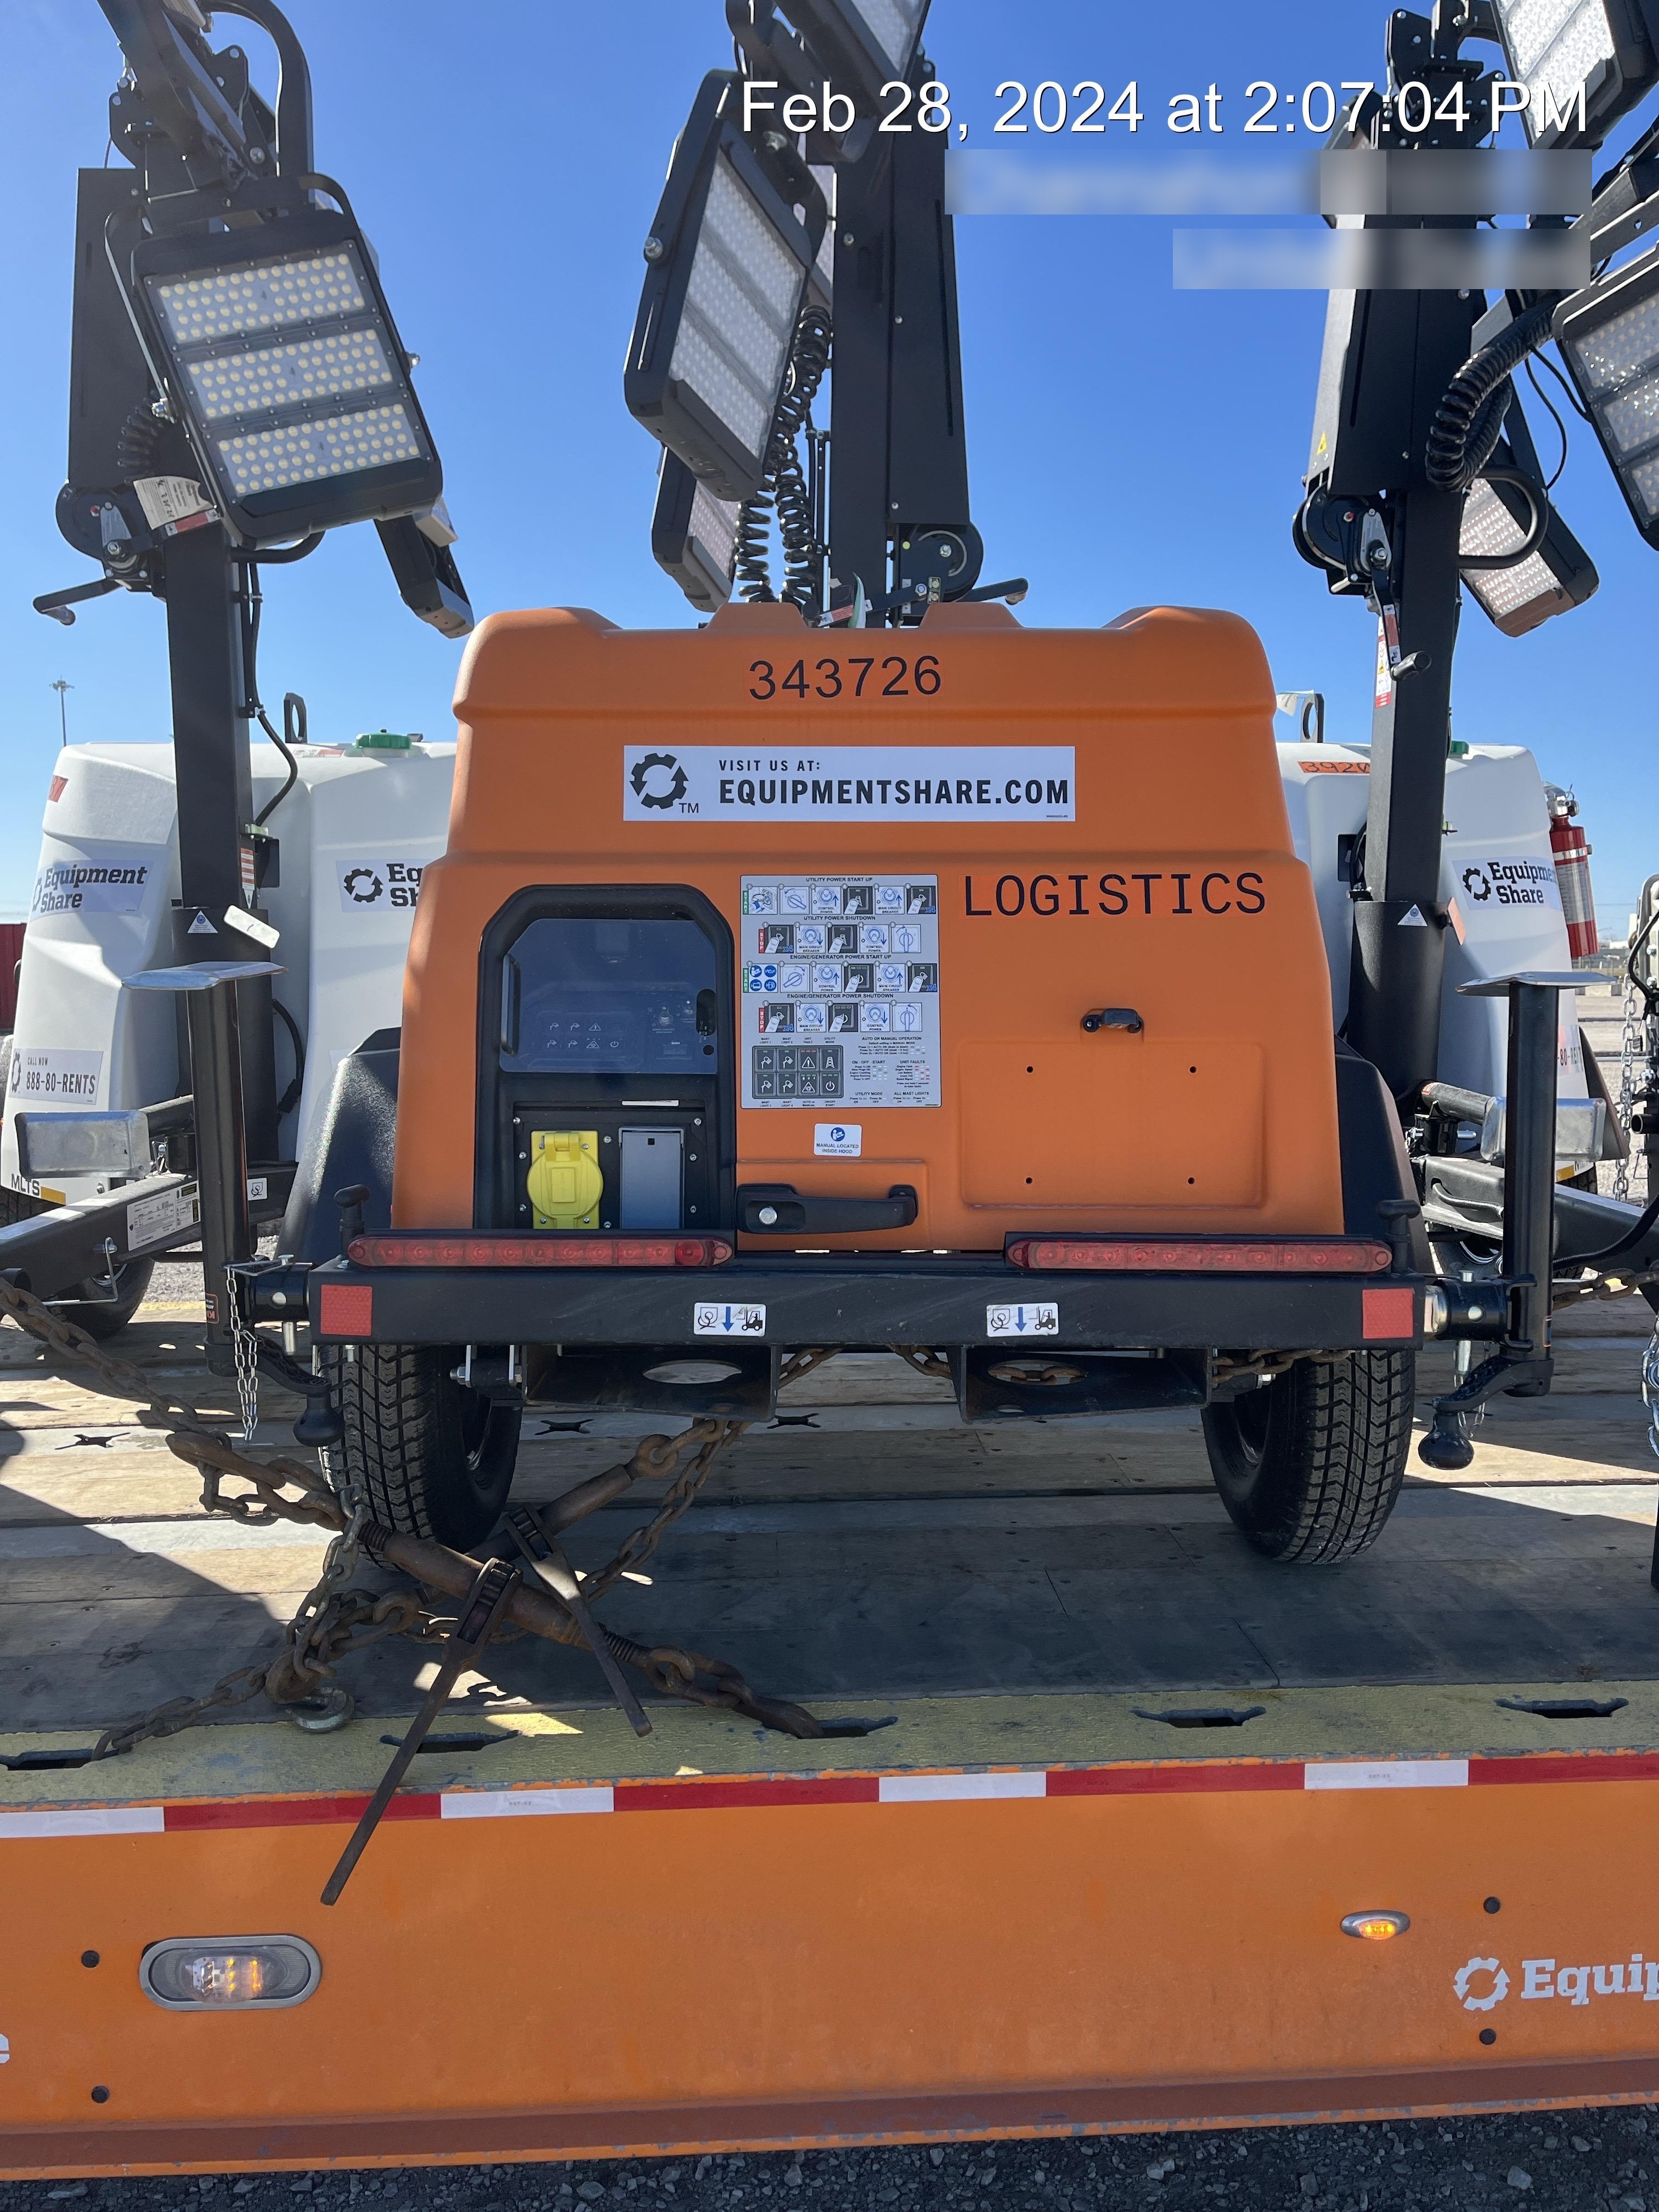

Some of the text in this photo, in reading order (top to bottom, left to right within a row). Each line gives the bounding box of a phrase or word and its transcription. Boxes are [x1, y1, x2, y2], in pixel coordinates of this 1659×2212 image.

[749, 656, 942, 701] 343726
[719, 760, 821, 771] VISIT US AT:
[719, 779, 1068, 806] EQUIPMENTSHARE.COM
[679, 803, 699, 814] TM
[44, 864, 148, 891] Equipment
[41, 891, 82, 913] Share
[965, 872, 1265, 916] LOGISTICS
[1496, 885, 1544, 904] Share
[27, 1057, 48, 1066] CALL NOW
[27, 1071, 95, 1094] 888-80-RENTS
